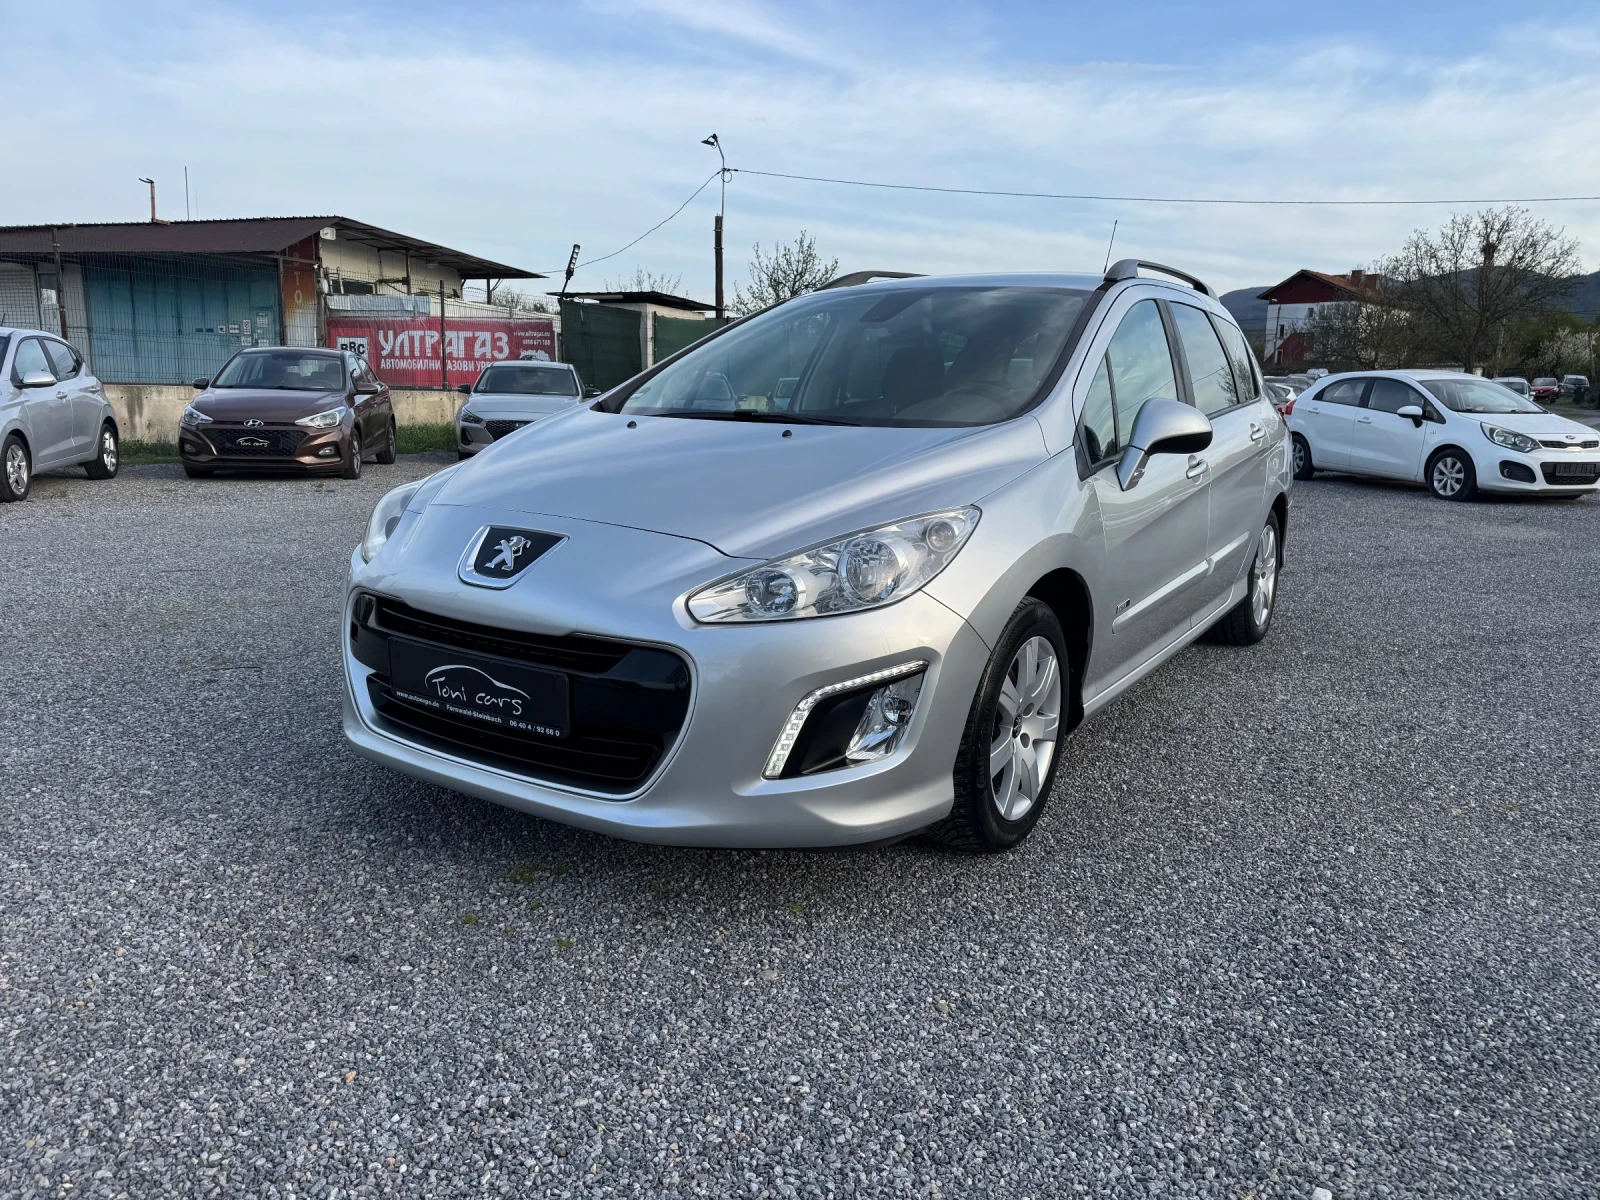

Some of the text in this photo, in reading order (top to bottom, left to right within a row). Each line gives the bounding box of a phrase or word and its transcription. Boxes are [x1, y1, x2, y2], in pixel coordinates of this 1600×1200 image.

[378, 330, 509, 359] УЛТРАГАЗ
[380, 358, 442, 371] АВТОМОБИЛНИ
[445, 360, 475, 372] АЗОВИ
[431, 676, 522, 715] Toni cars
[446, 704, 502, 724] Fernwald-Steinbach
